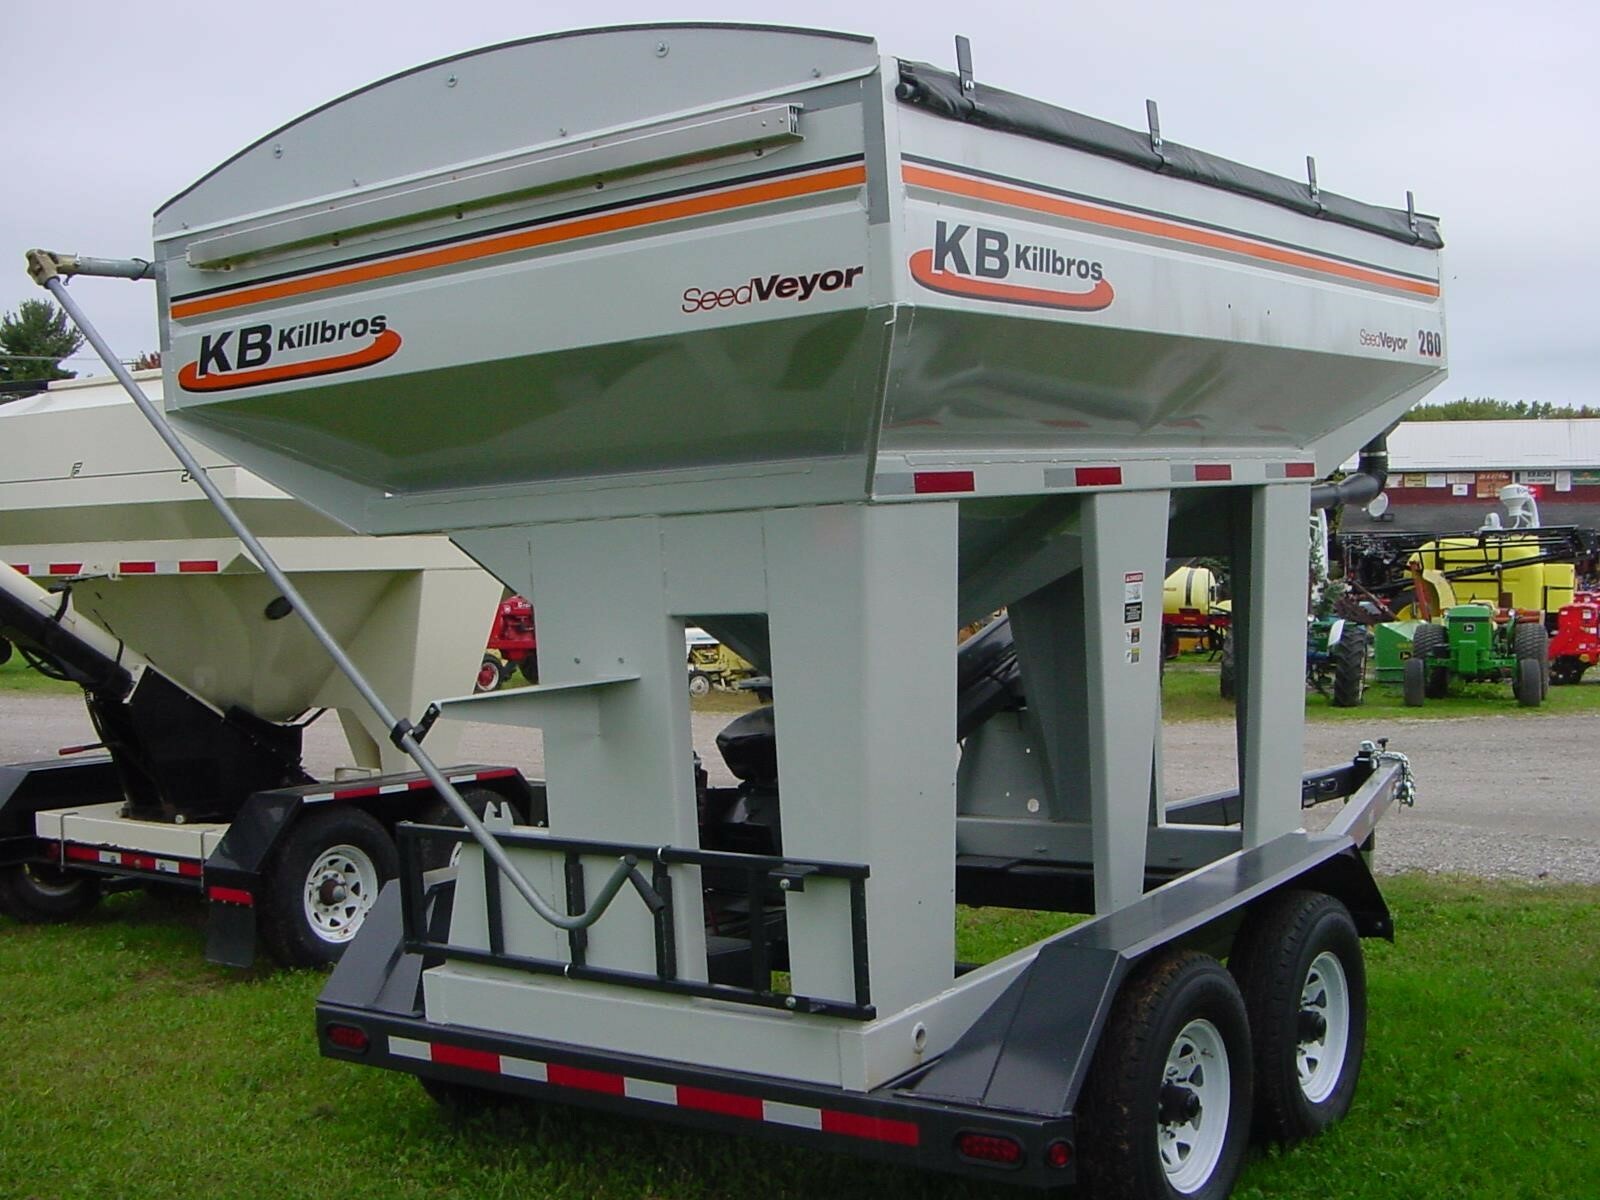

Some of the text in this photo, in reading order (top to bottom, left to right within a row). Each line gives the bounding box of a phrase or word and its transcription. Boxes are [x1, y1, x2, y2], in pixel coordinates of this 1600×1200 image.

[934, 220, 1103, 281] KB Killbros
[682, 265, 864, 313] SeedVeyor
[198, 315, 387, 376] KB Killbros
[1359, 329, 1408, 352] SeedVeyor
